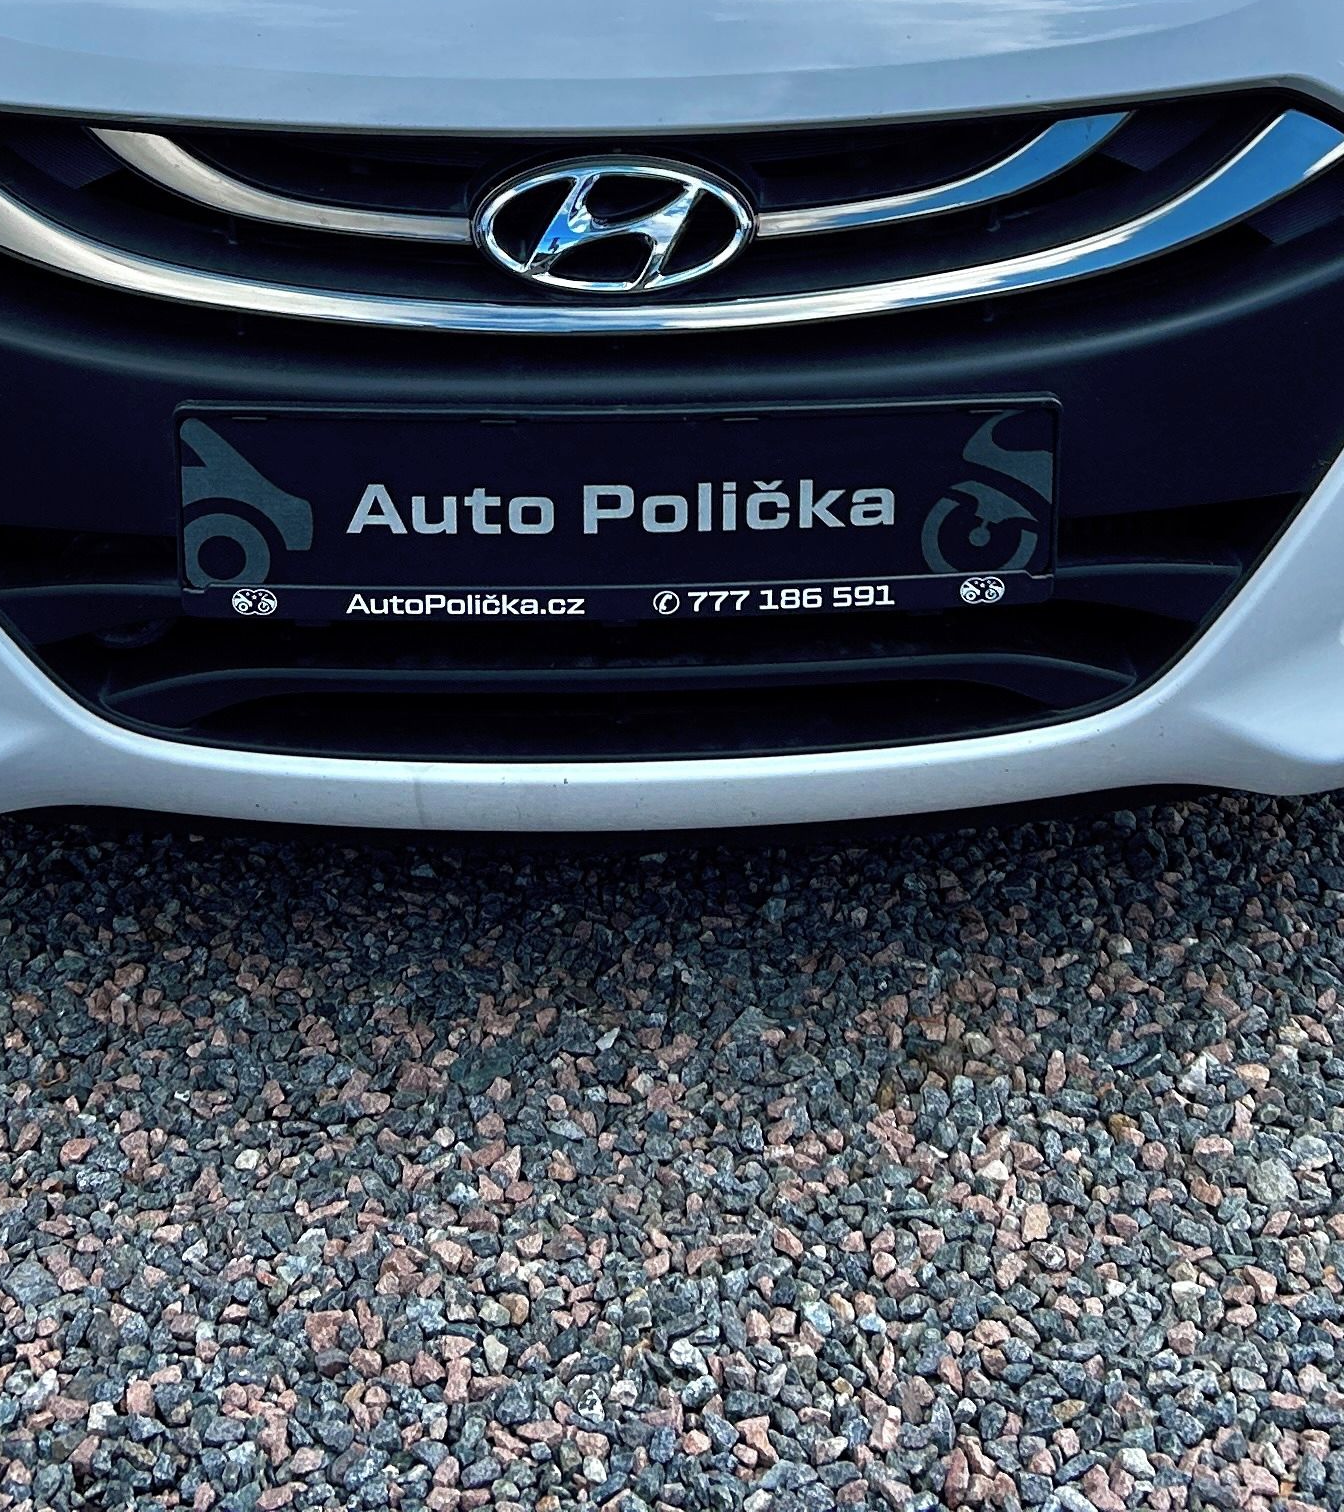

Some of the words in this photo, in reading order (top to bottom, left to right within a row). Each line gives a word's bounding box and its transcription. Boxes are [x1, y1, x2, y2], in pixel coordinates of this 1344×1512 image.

[346, 484, 555, 534] Auto
[583, 479, 895, 534] Polička
[346, 593, 586, 615] AutoPolička.cz
[688, 590, 750, 612] 777
[759, 588, 823, 610] 186
[833, 585, 895, 607] 591
